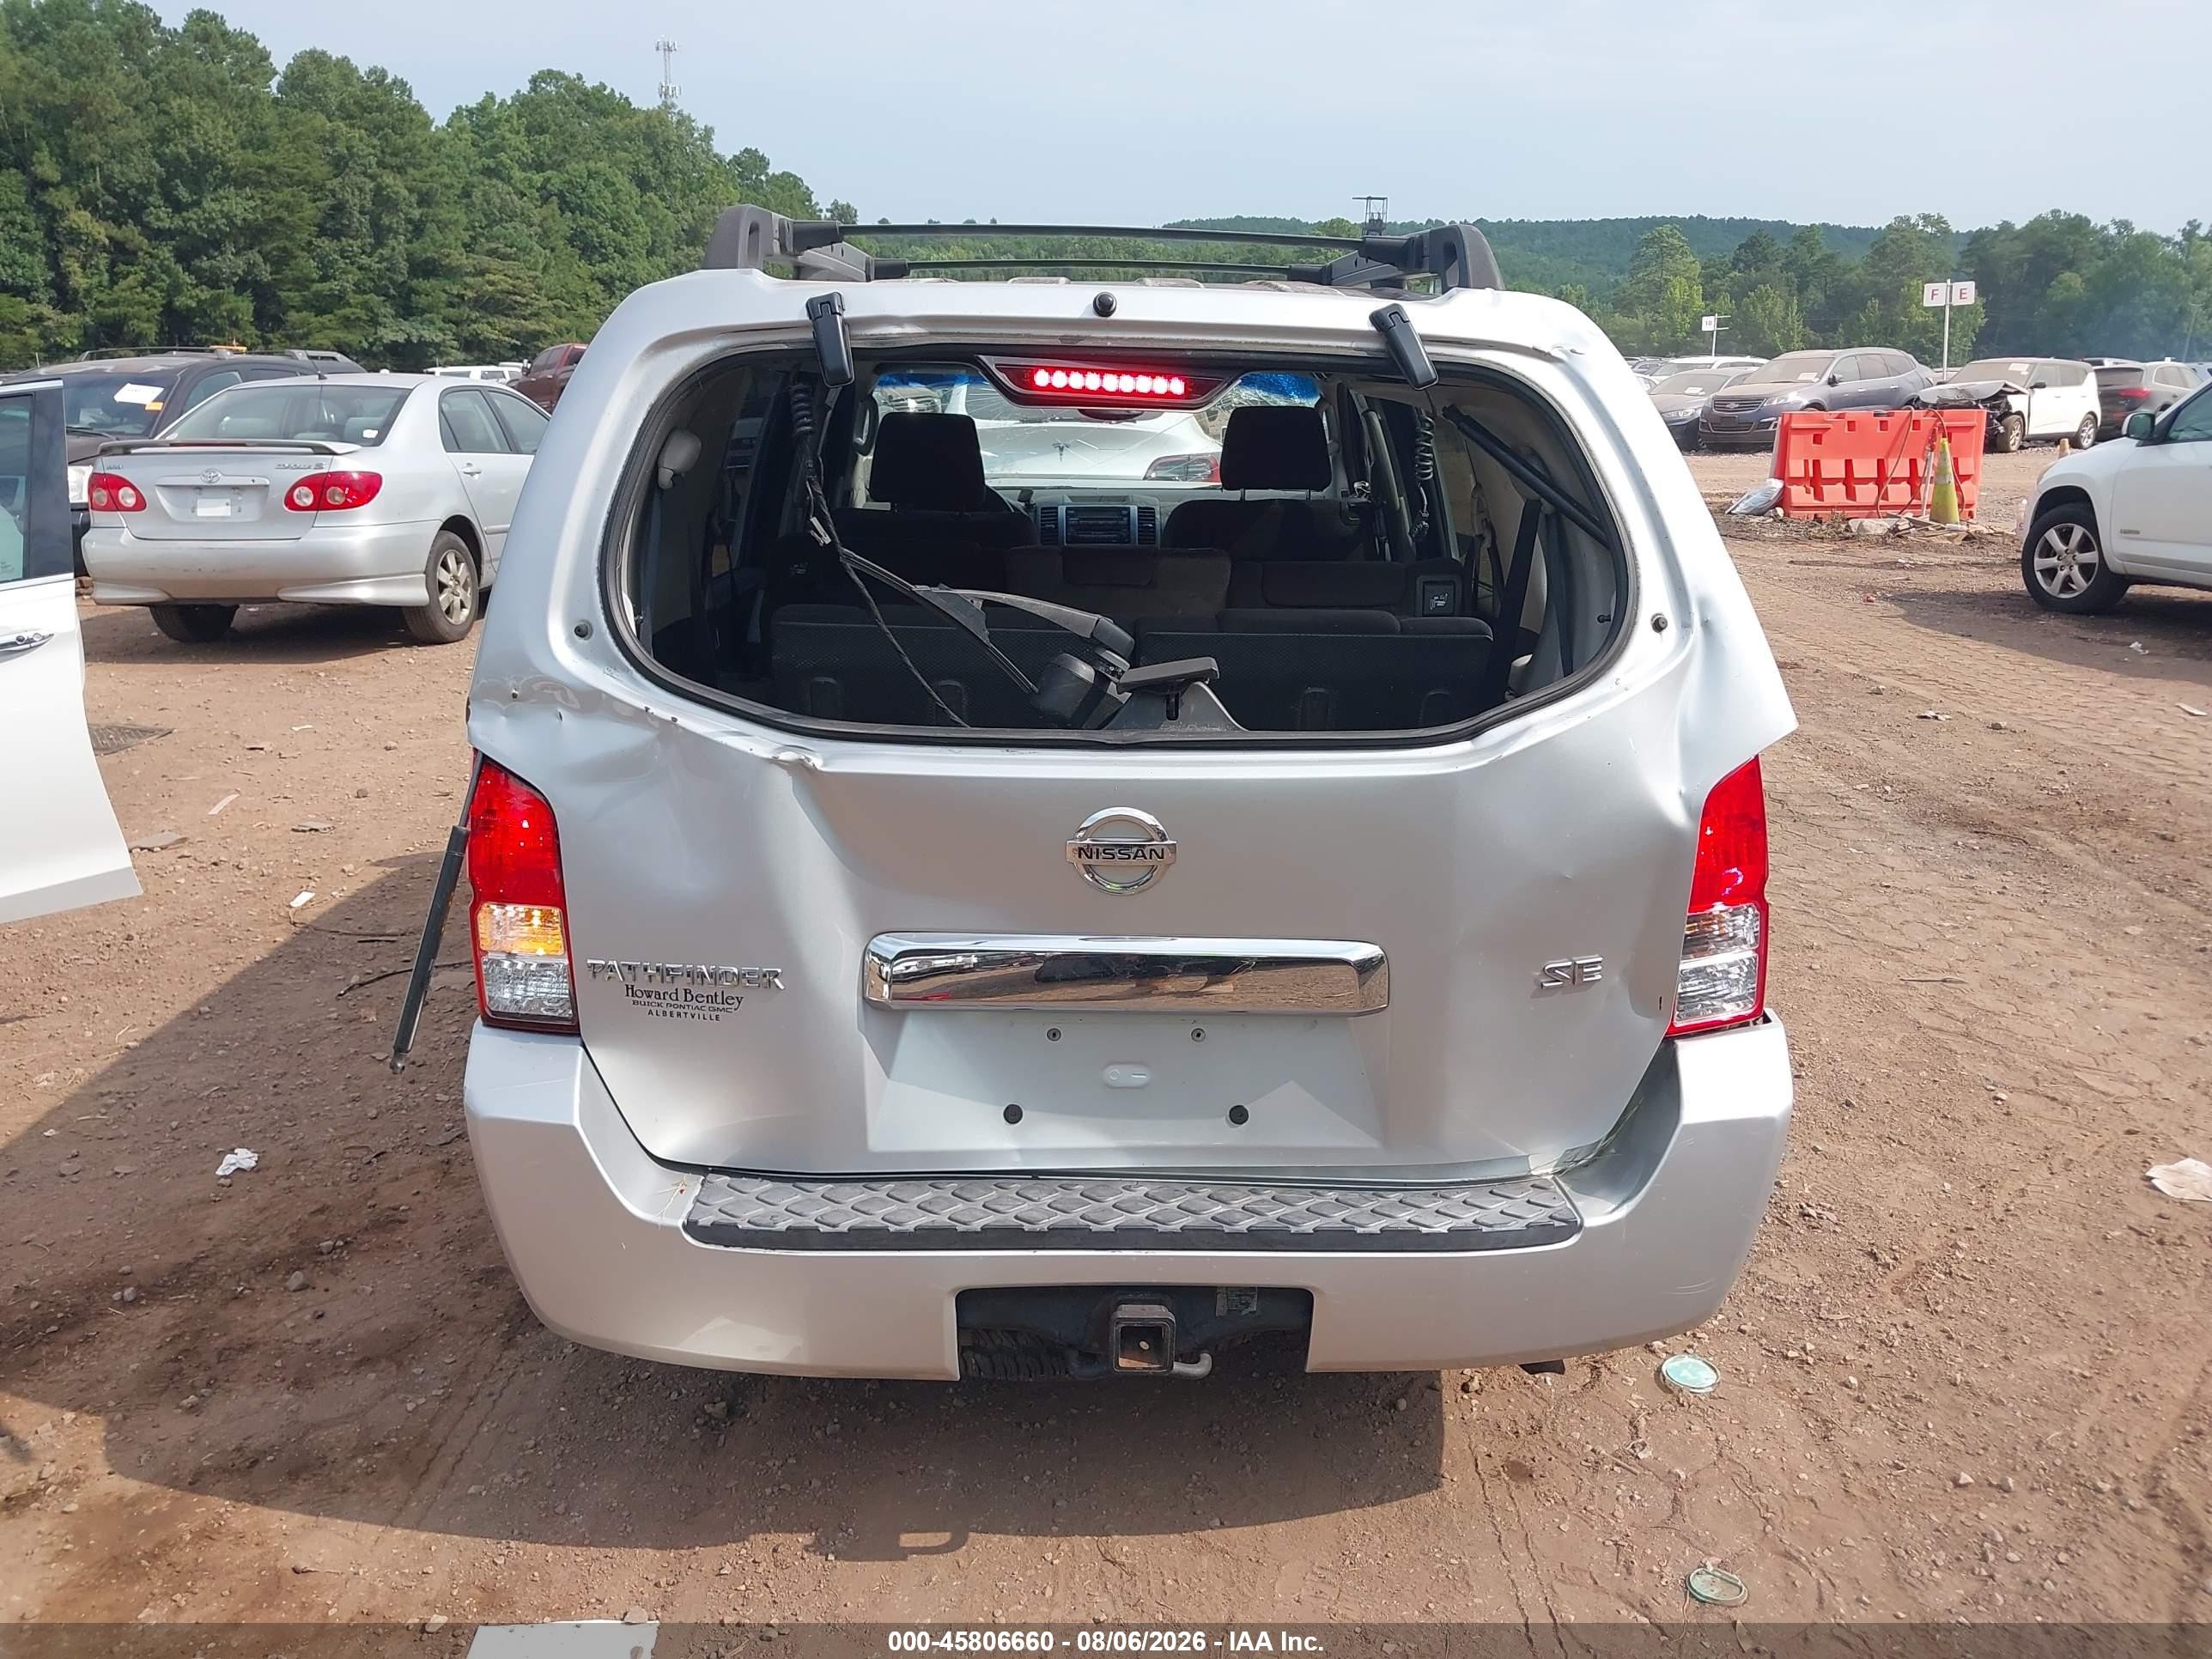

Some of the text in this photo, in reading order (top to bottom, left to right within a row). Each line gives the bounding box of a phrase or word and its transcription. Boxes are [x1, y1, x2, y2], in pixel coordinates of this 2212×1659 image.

[1930, 289, 1939, 301] F
[1959, 288, 1967, 300] E
[1077, 847, 1164, 860] NISSAN
[586, 957, 786, 990] PATHFINDER
[1540, 955, 1603, 988] SE
[624, 983, 744, 1012] Howard Bentley
[632, 1000, 664, 1008] BUICK
[665, 1002, 706, 1012] PONTIAC
[647, 1009, 720, 1022] ALBERTVILLE
